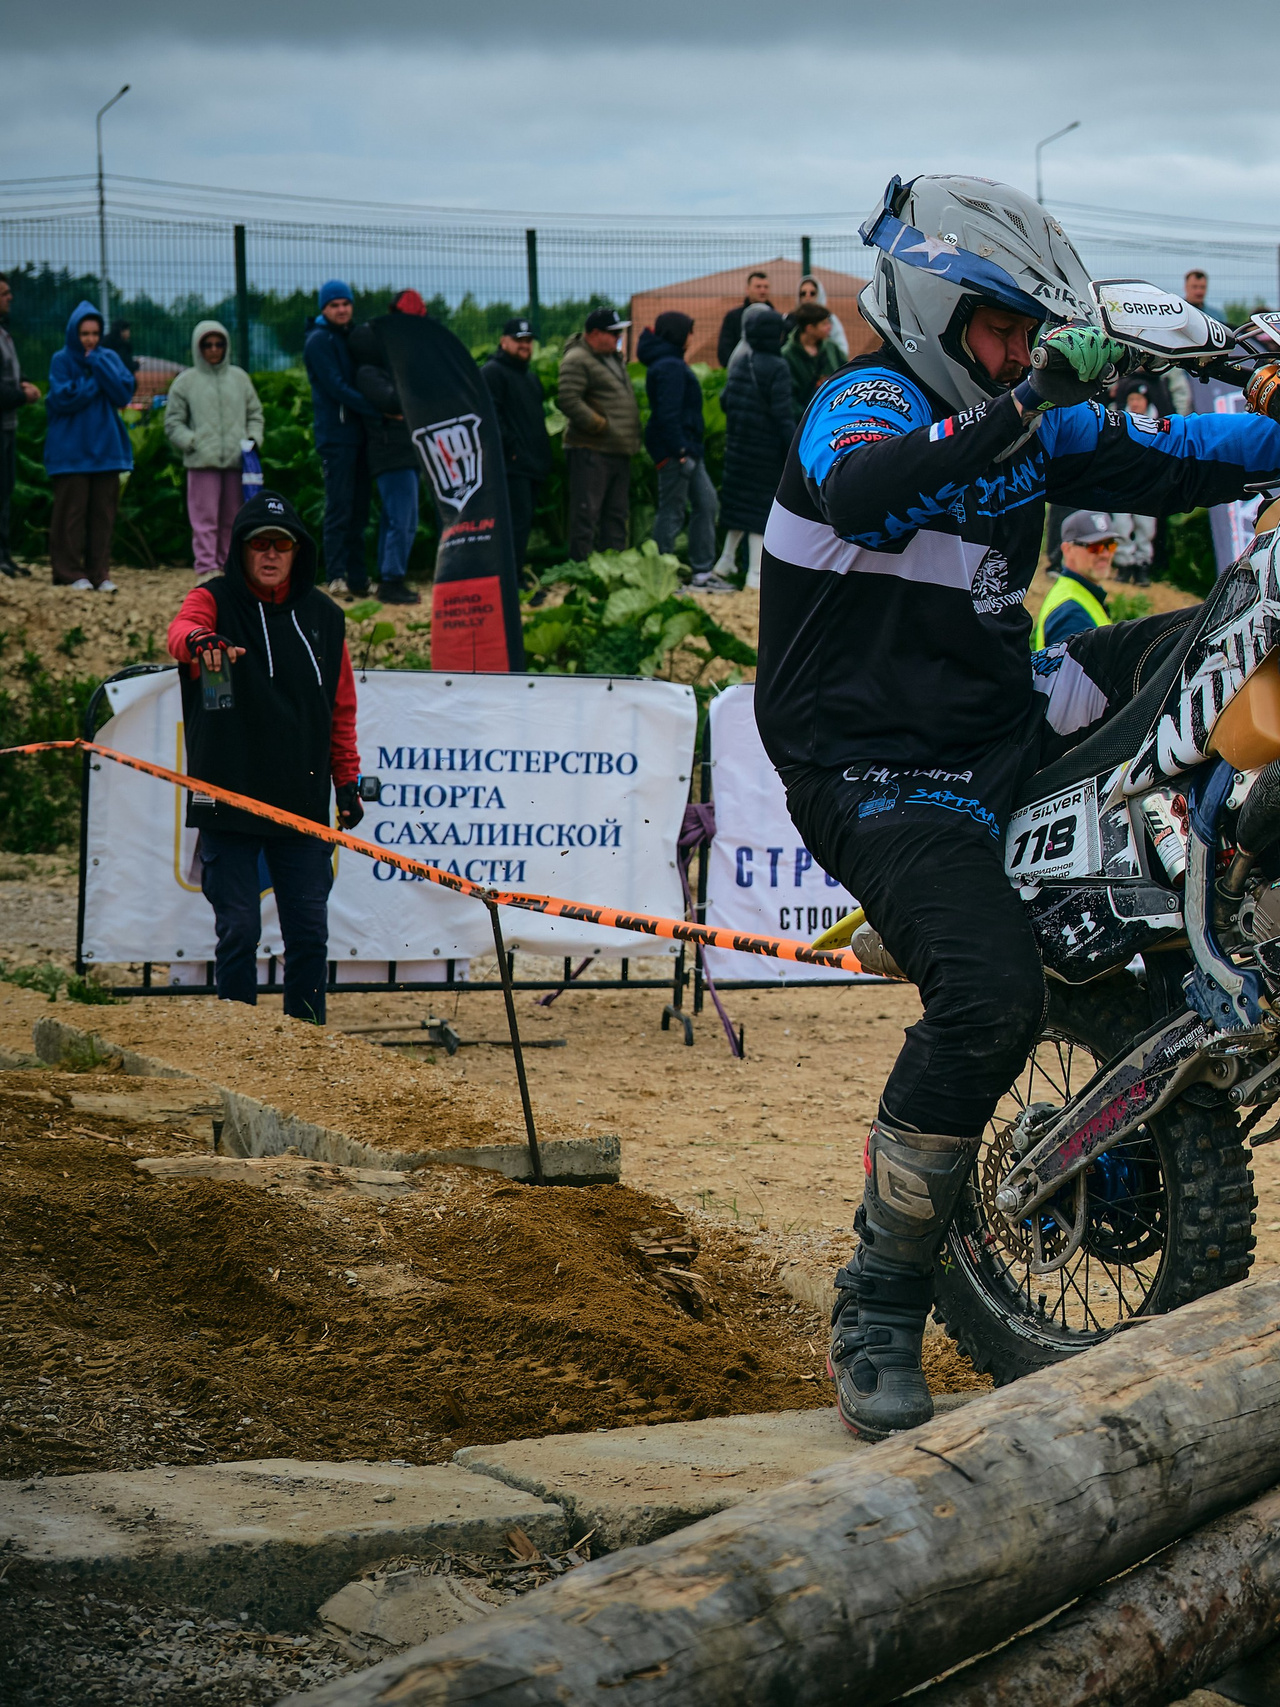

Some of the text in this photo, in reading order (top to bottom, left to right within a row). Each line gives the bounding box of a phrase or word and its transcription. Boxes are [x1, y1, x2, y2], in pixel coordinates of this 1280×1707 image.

[1031, 281, 1100, 320] AIRO
[1107, 300, 1184, 317] X-GRIP.RU
[831, 379, 903, 409] ENDURO
[850, 389, 912, 413] STORM
[434, 603, 495, 620] ENDURO
[442, 616, 486, 630] RALLY
[377, 746, 639, 775] МИНИСТЕРСТВО
[378, 783, 507, 809] СПОРТА
[908, 788, 1000, 836] SAPTRANS
[374, 817, 623, 848] САХАЛИНСКОЙ
[1010, 814, 1078, 869] 118
[736, 846, 840, 888] СТР
[779, 905, 860, 935] строи
[1085, 926, 1106, 943] ARMOUR
[1163, 1023, 1206, 1058] Husqvarna
